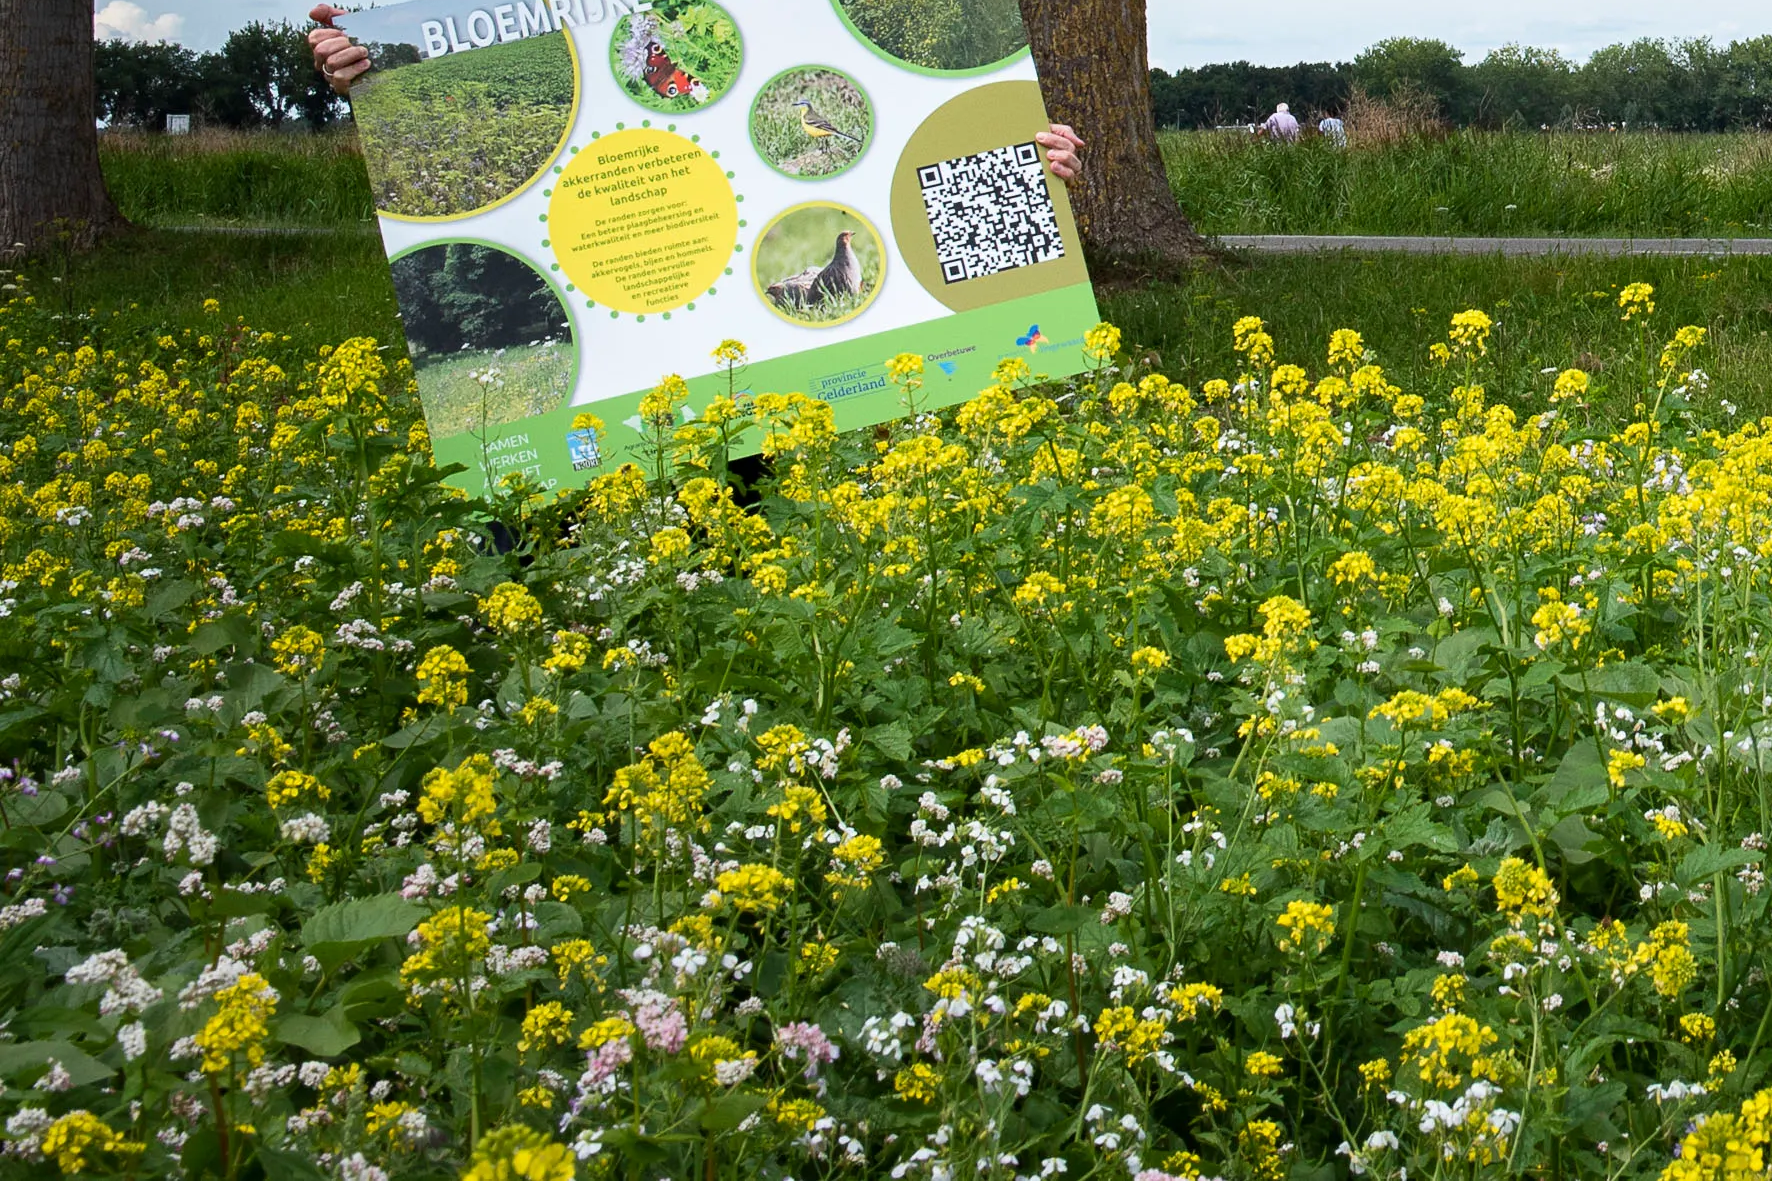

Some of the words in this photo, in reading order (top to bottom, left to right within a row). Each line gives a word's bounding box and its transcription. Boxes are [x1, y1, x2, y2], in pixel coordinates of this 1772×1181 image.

[598, 144, 660, 165] Bloemrijke
[562, 164, 635, 188] akkerranden
[637, 150, 702, 170] verbeteren
[577, 189, 592, 199] de
[594, 175, 646, 195] kwaliteit
[648, 172, 669, 183] van
[671, 166, 691, 178] het
[610, 186, 668, 206] landschap
[581, 231, 596, 240] Een
[598, 224, 625, 237] betere
[626, 209, 692, 231] plaagbeheersing
[694, 206, 704, 214] en
[595, 219, 606, 227] De
[608, 212, 636, 224] randen
[637, 206, 665, 218] zorgen
[666, 201, 688, 210] voor:
[571, 233, 630, 252] waterkwaliteit
[632, 230, 642, 238] en
[644, 226, 665, 235] meer
[665, 212, 720, 231] biodiversiteit
[592, 260, 604, 268] De
[605, 253, 634, 265] randen
[635, 247, 662, 258] bieden
[664, 240, 691, 252] ruimte
[643, 257, 664, 267] bijen
[615, 275, 628, 283] De
[628, 268, 656, 280] randen
[657, 259, 695, 273] vervullen
[623, 271, 690, 292] landschappelijke
[643, 282, 689, 297] recreatieve
[646, 294, 679, 307] functies
[927, 344, 977, 362] Overbetuwe
[817, 376, 886, 401] Gelderland
[821, 368, 867, 389] provincie
[480, 433, 529, 455] SAMEN
